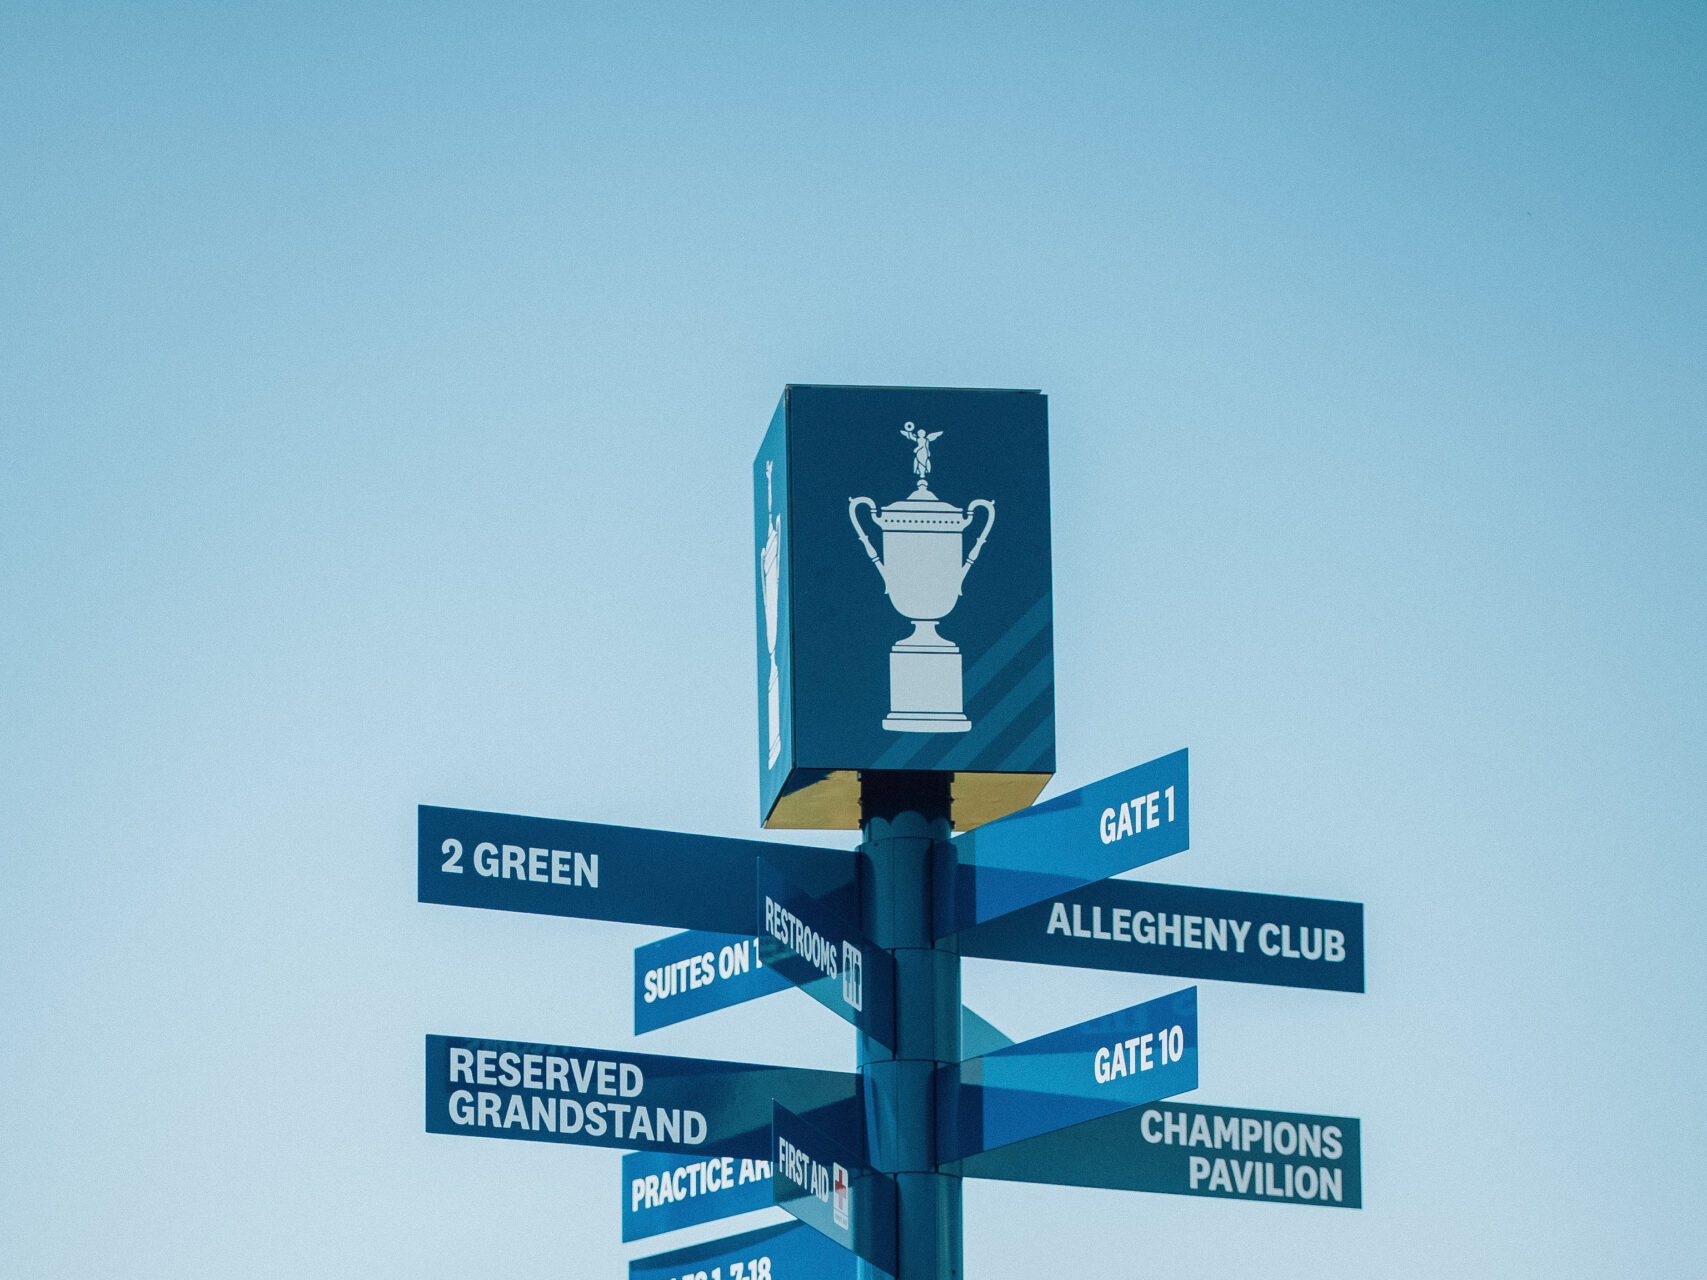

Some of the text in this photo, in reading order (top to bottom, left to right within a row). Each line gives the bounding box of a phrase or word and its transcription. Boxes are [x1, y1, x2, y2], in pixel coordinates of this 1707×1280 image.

[1099, 785, 1176, 845] GATE 1
[441, 838, 599, 888] 2 GREEN
[765, 896, 838, 980] RESTROOMS
[1047, 902, 1346, 962] ALLEGHENY CLUB
[644, 951, 715, 1003] SUITES
[718, 940, 750, 980] ON
[449, 1047, 644, 1098] RESERVED
[1094, 1024, 1184, 1084] GATE 10
[448, 1091, 708, 1146] GRANDSTAND
[1140, 1109, 1343, 1160] CHAMPIONS
[632, 1156, 773, 1212] PRACTICE AR
[779, 1136, 829, 1203] FIRST AID
[1188, 1156, 1343, 1202] PAVILION
